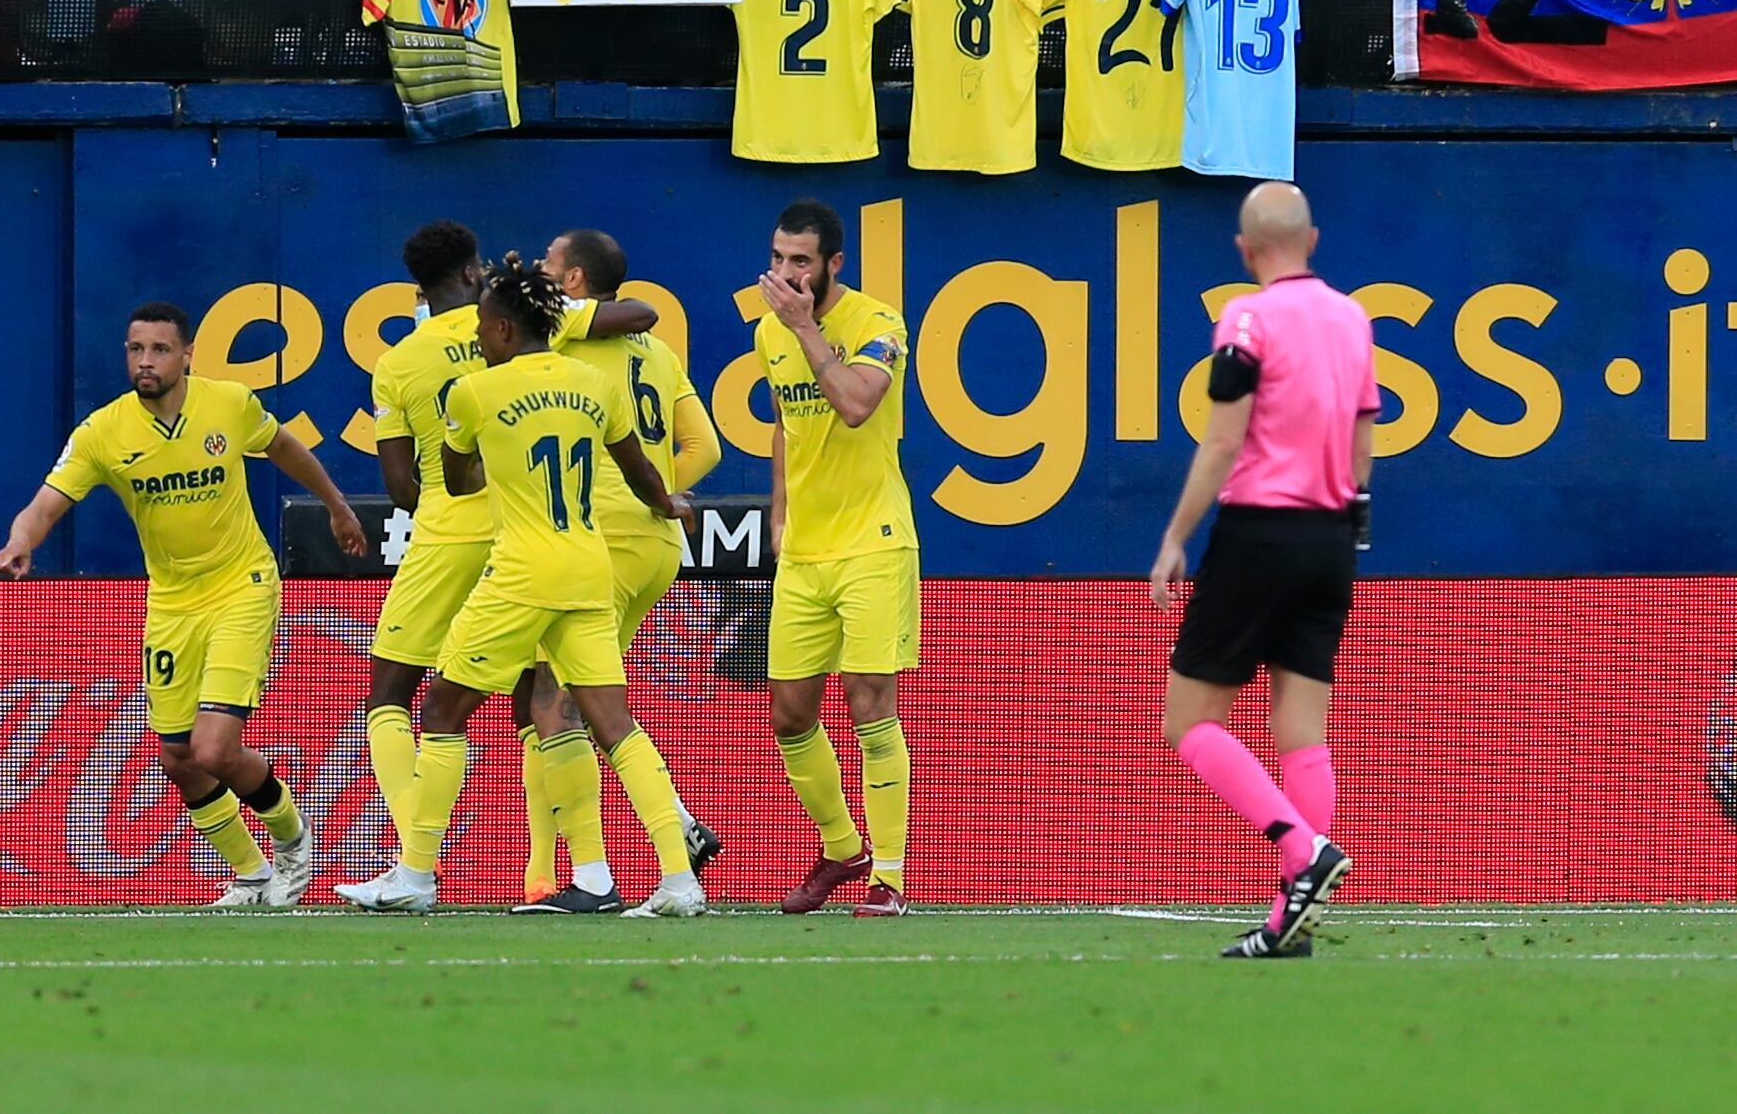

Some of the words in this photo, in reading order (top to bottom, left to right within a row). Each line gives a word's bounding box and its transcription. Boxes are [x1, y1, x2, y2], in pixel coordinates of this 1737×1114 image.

[497, 389, 608, 430] CHUKWUEZE
[628, 353, 667, 446] 6
[773, 381, 826, 404] PAME
[130, 465, 226, 495] PAMESA
[526, 434, 595, 533] 11
[144, 646, 175, 686] 19
